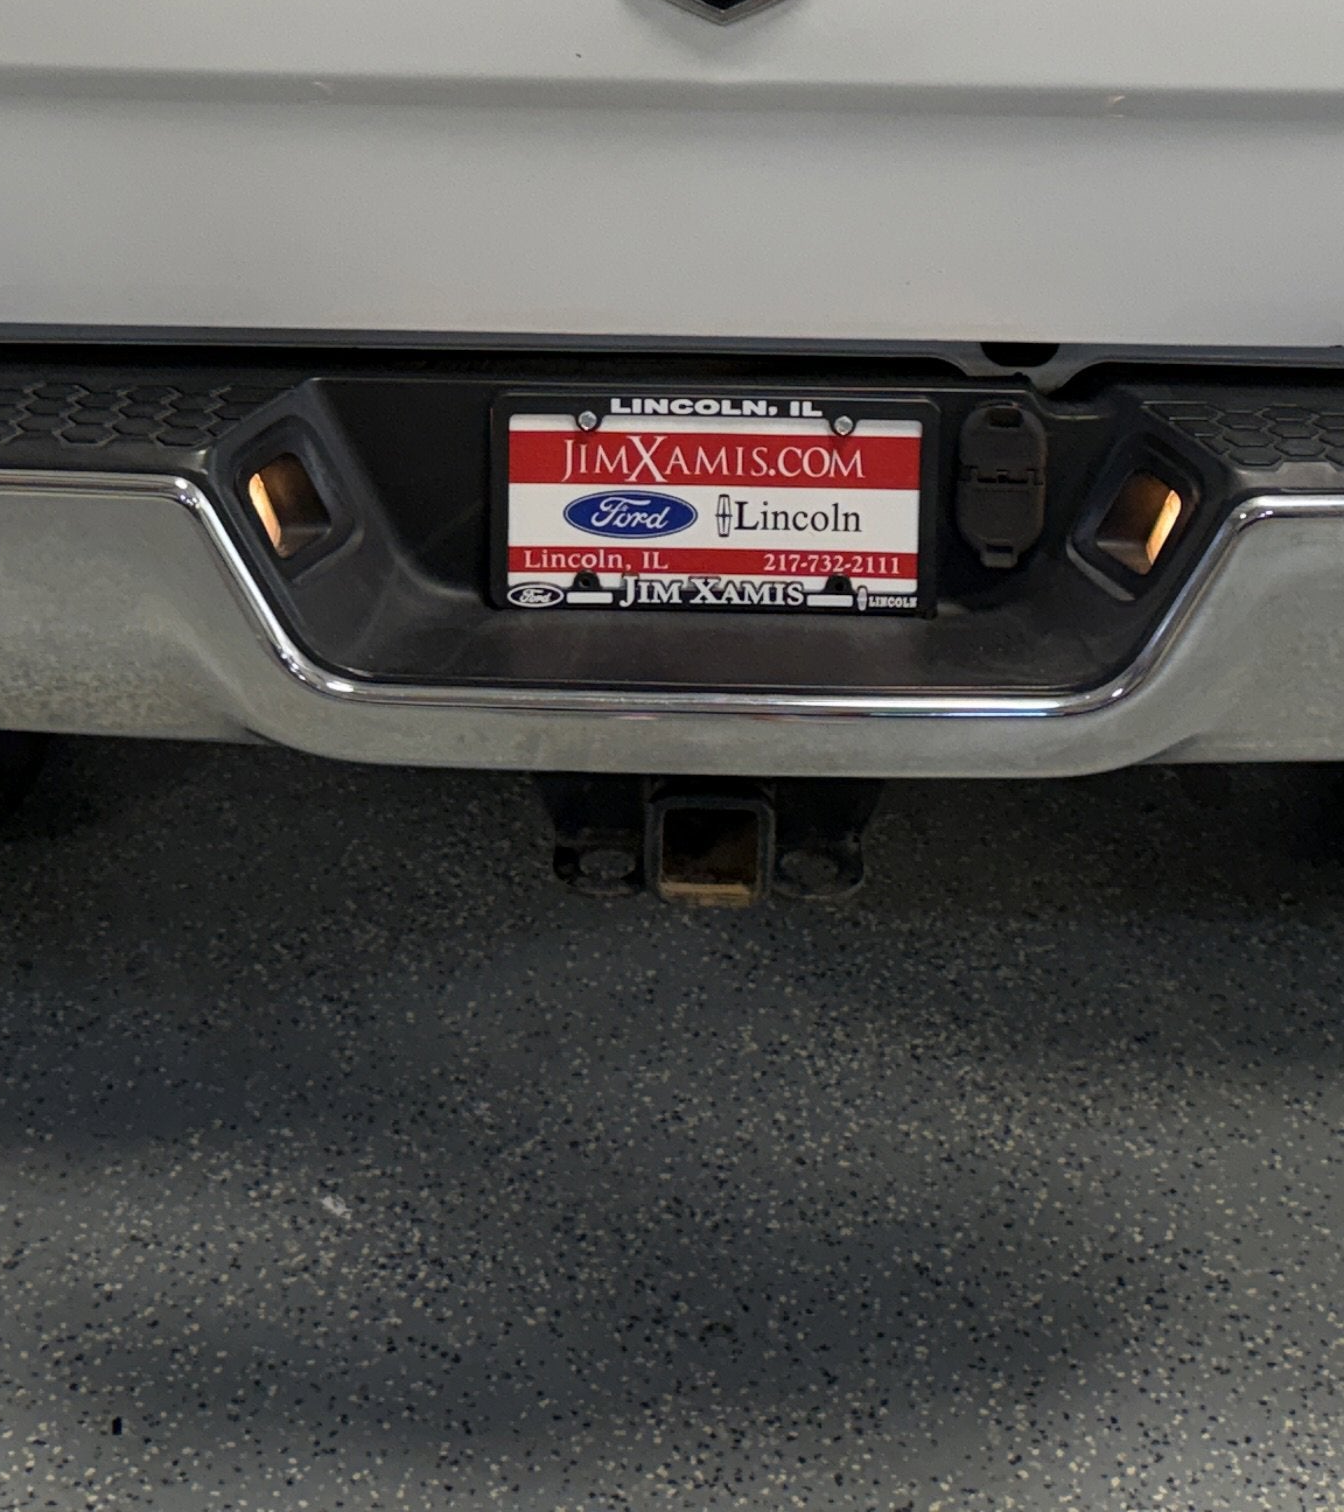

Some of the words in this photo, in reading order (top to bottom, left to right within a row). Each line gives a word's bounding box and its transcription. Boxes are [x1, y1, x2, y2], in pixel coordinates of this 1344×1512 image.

[610, 398, 778, 417] LINCOLN,
[789, 400, 824, 417] IL
[560, 435, 867, 483] JIMXAMIS.COM
[590, 496, 672, 529] Ford
[734, 500, 863, 533] Lincoln
[524, 549, 632, 571] Lincoln,
[643, 551, 669, 569] IL
[763, 553, 901, 575] 217-732-2111
[619, 575, 683, 608] JIM
[688, 576, 805, 607] XAMIS
[868, 596, 918, 609] LINCOLN
